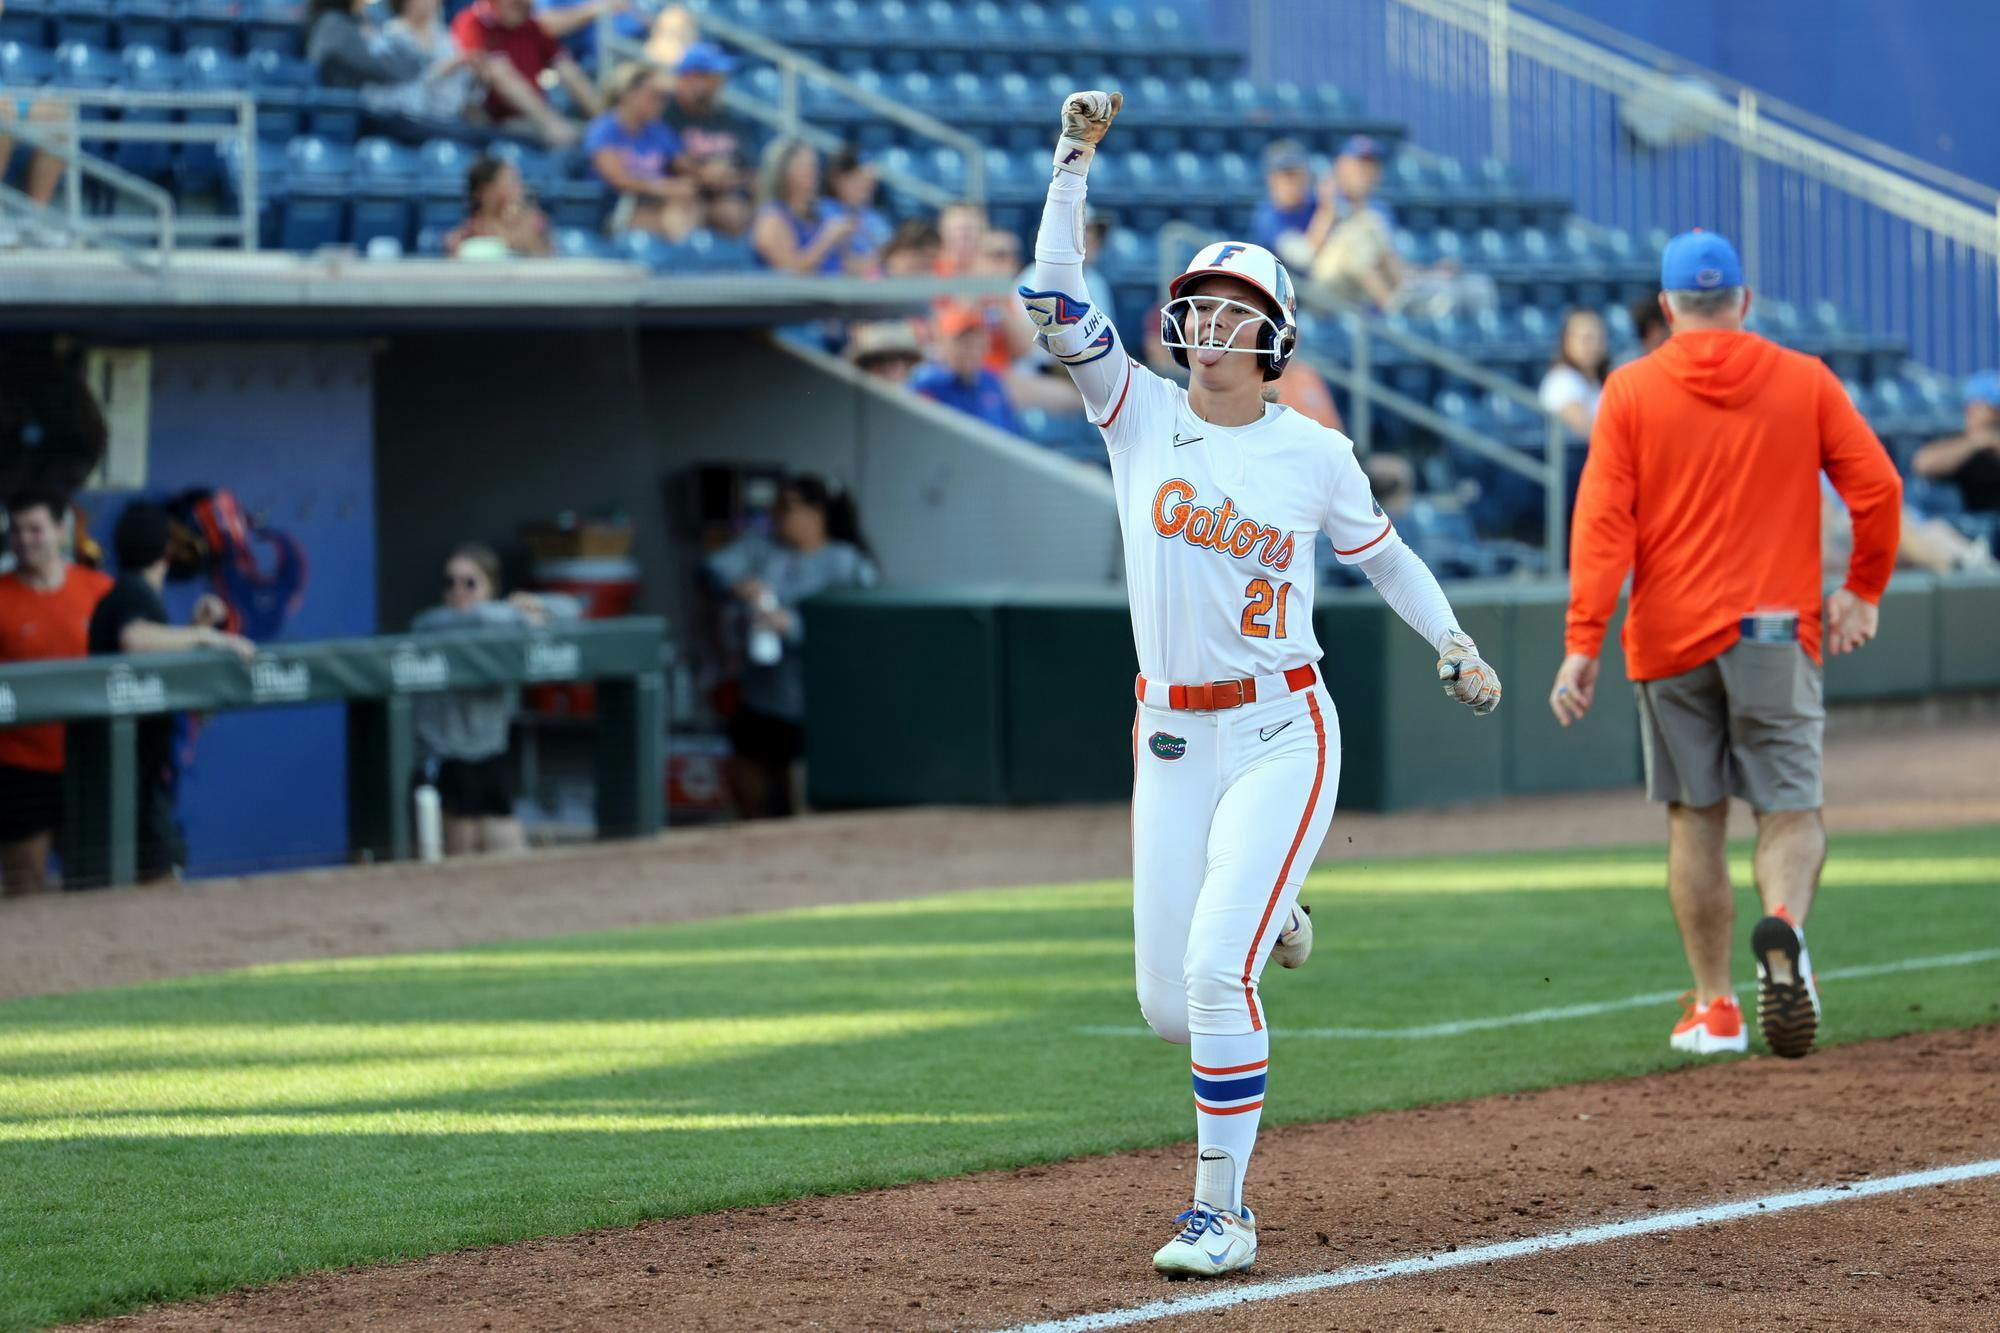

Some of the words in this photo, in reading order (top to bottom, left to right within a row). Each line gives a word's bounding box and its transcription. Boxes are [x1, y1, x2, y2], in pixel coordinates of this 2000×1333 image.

[1061, 148, 1083, 165] F
[1208, 245, 1246, 267] F
[1152, 478, 1295, 572] Gators
[1241, 578, 1292, 639] 21
